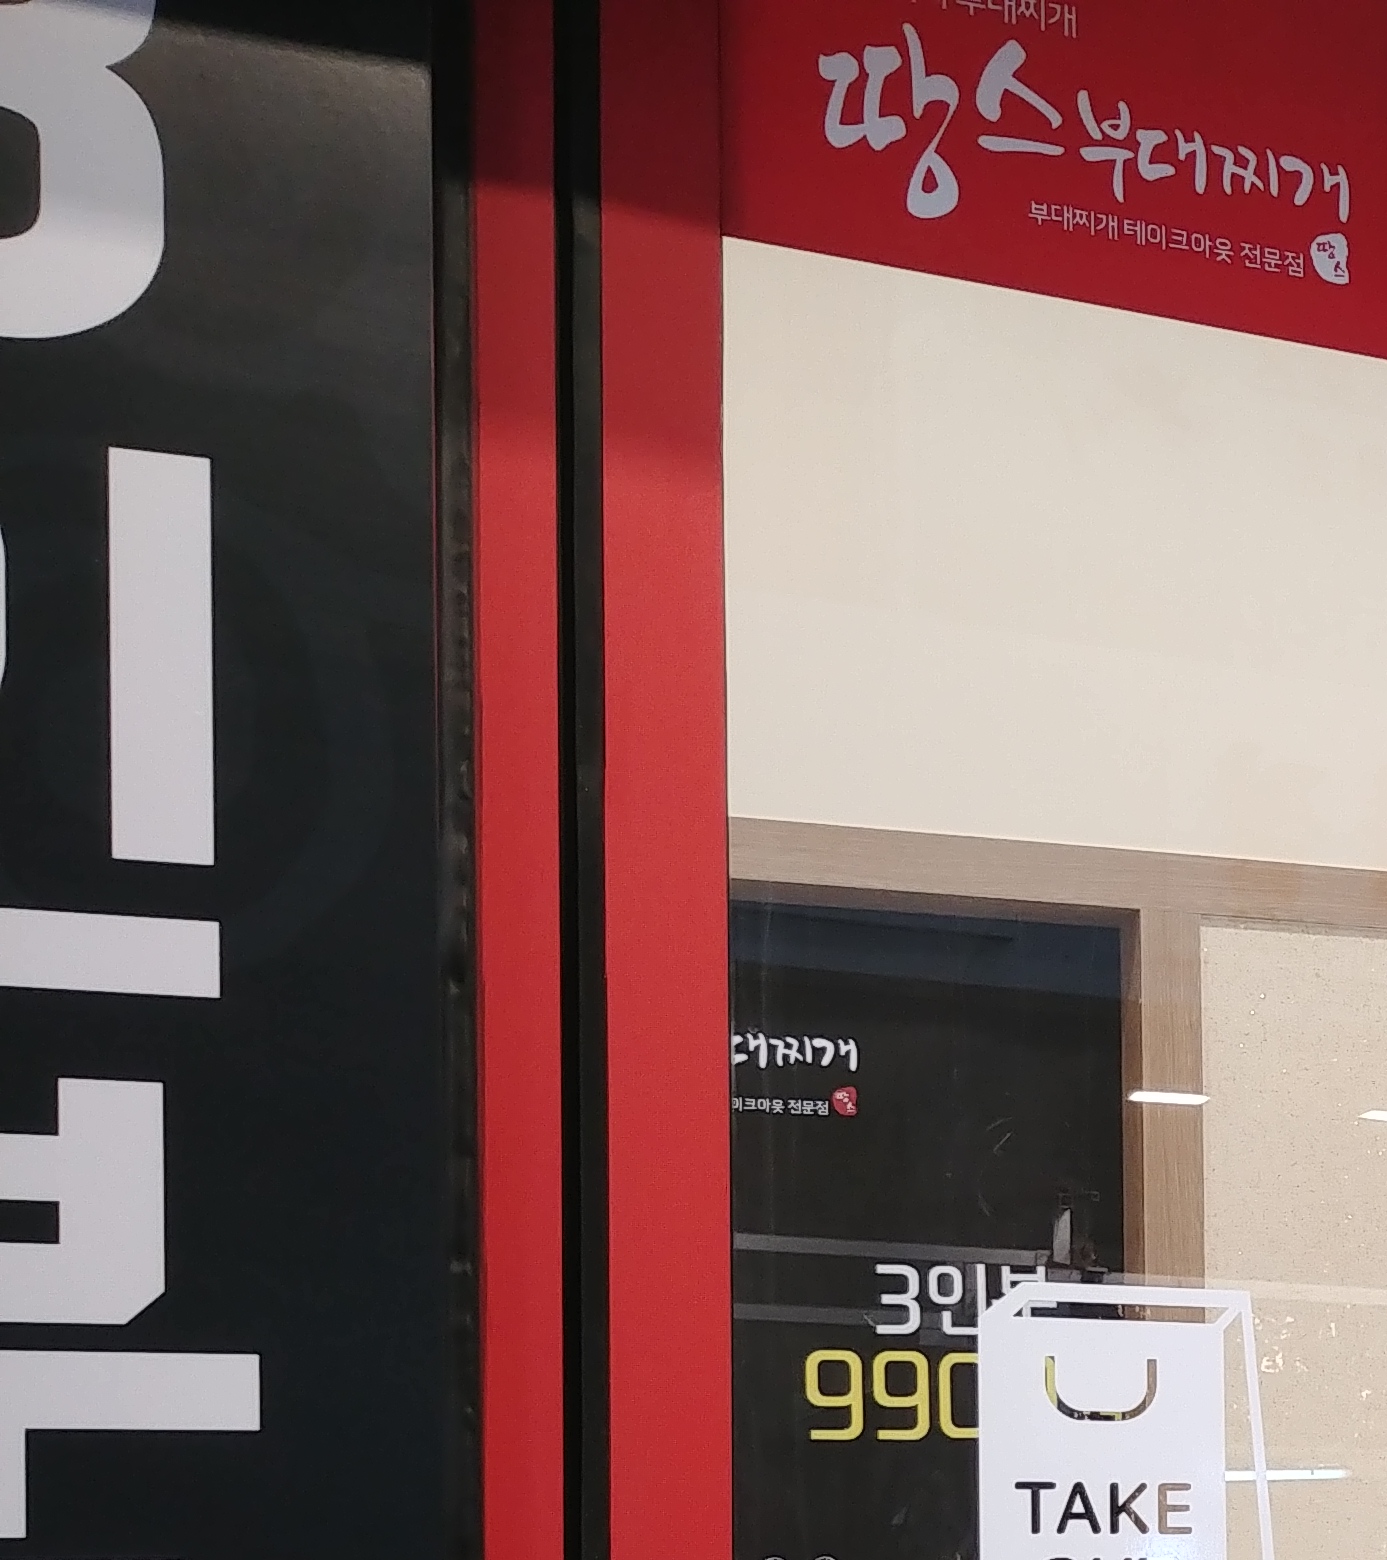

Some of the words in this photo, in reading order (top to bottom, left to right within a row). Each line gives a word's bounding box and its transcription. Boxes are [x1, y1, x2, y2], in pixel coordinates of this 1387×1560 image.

[1028, 200, 1119, 241] 부대찌개
[1123, 218, 1235, 264] 테이크아웃
[1239, 242, 1305, 278] 전문점
[788, 1098, 829, 1116] 전문점
[1013, 1480, 1193, 1536] TAKE
